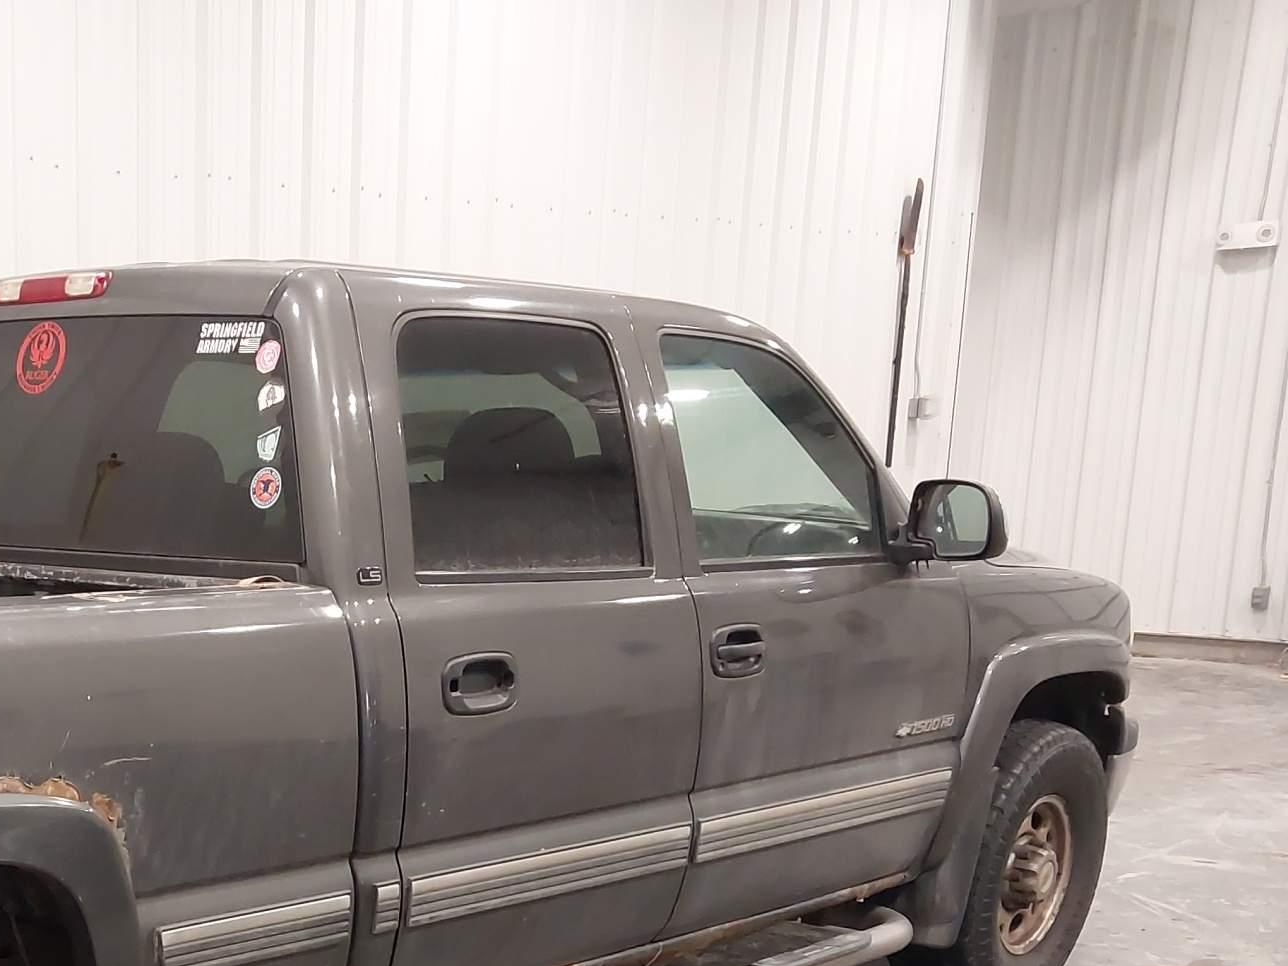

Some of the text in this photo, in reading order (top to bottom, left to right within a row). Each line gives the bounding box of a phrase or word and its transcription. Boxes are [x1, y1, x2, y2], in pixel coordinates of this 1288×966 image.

[199, 321, 266, 339] SPRINGFIELD
[196, 338, 238, 354] ARMORY
[359, 569, 382, 583] LS
